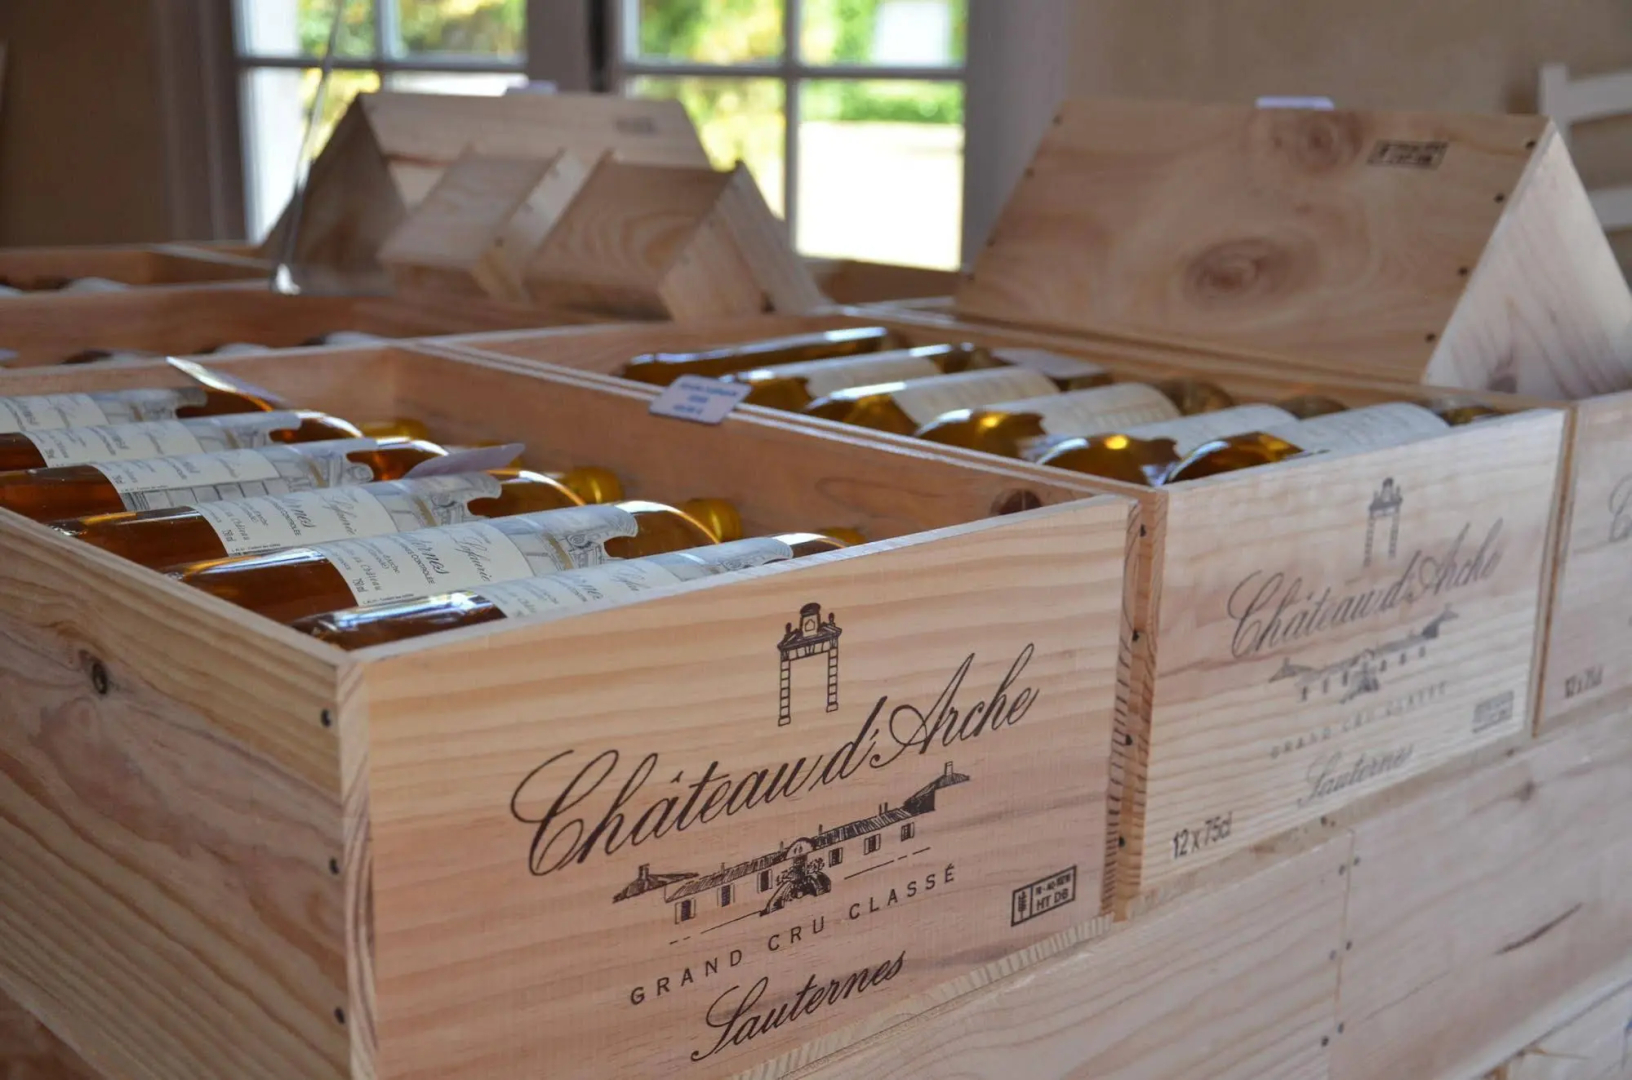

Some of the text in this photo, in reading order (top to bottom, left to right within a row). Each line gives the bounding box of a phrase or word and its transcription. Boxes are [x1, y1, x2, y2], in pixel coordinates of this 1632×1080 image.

[1227, 569, 1378, 658] Château
[511, 643, 1039, 876] Château d'Arche
[630, 863, 955, 1006] GRAND CRU CLASSÉ
[690, 950, 906, 1062] Sauternes
